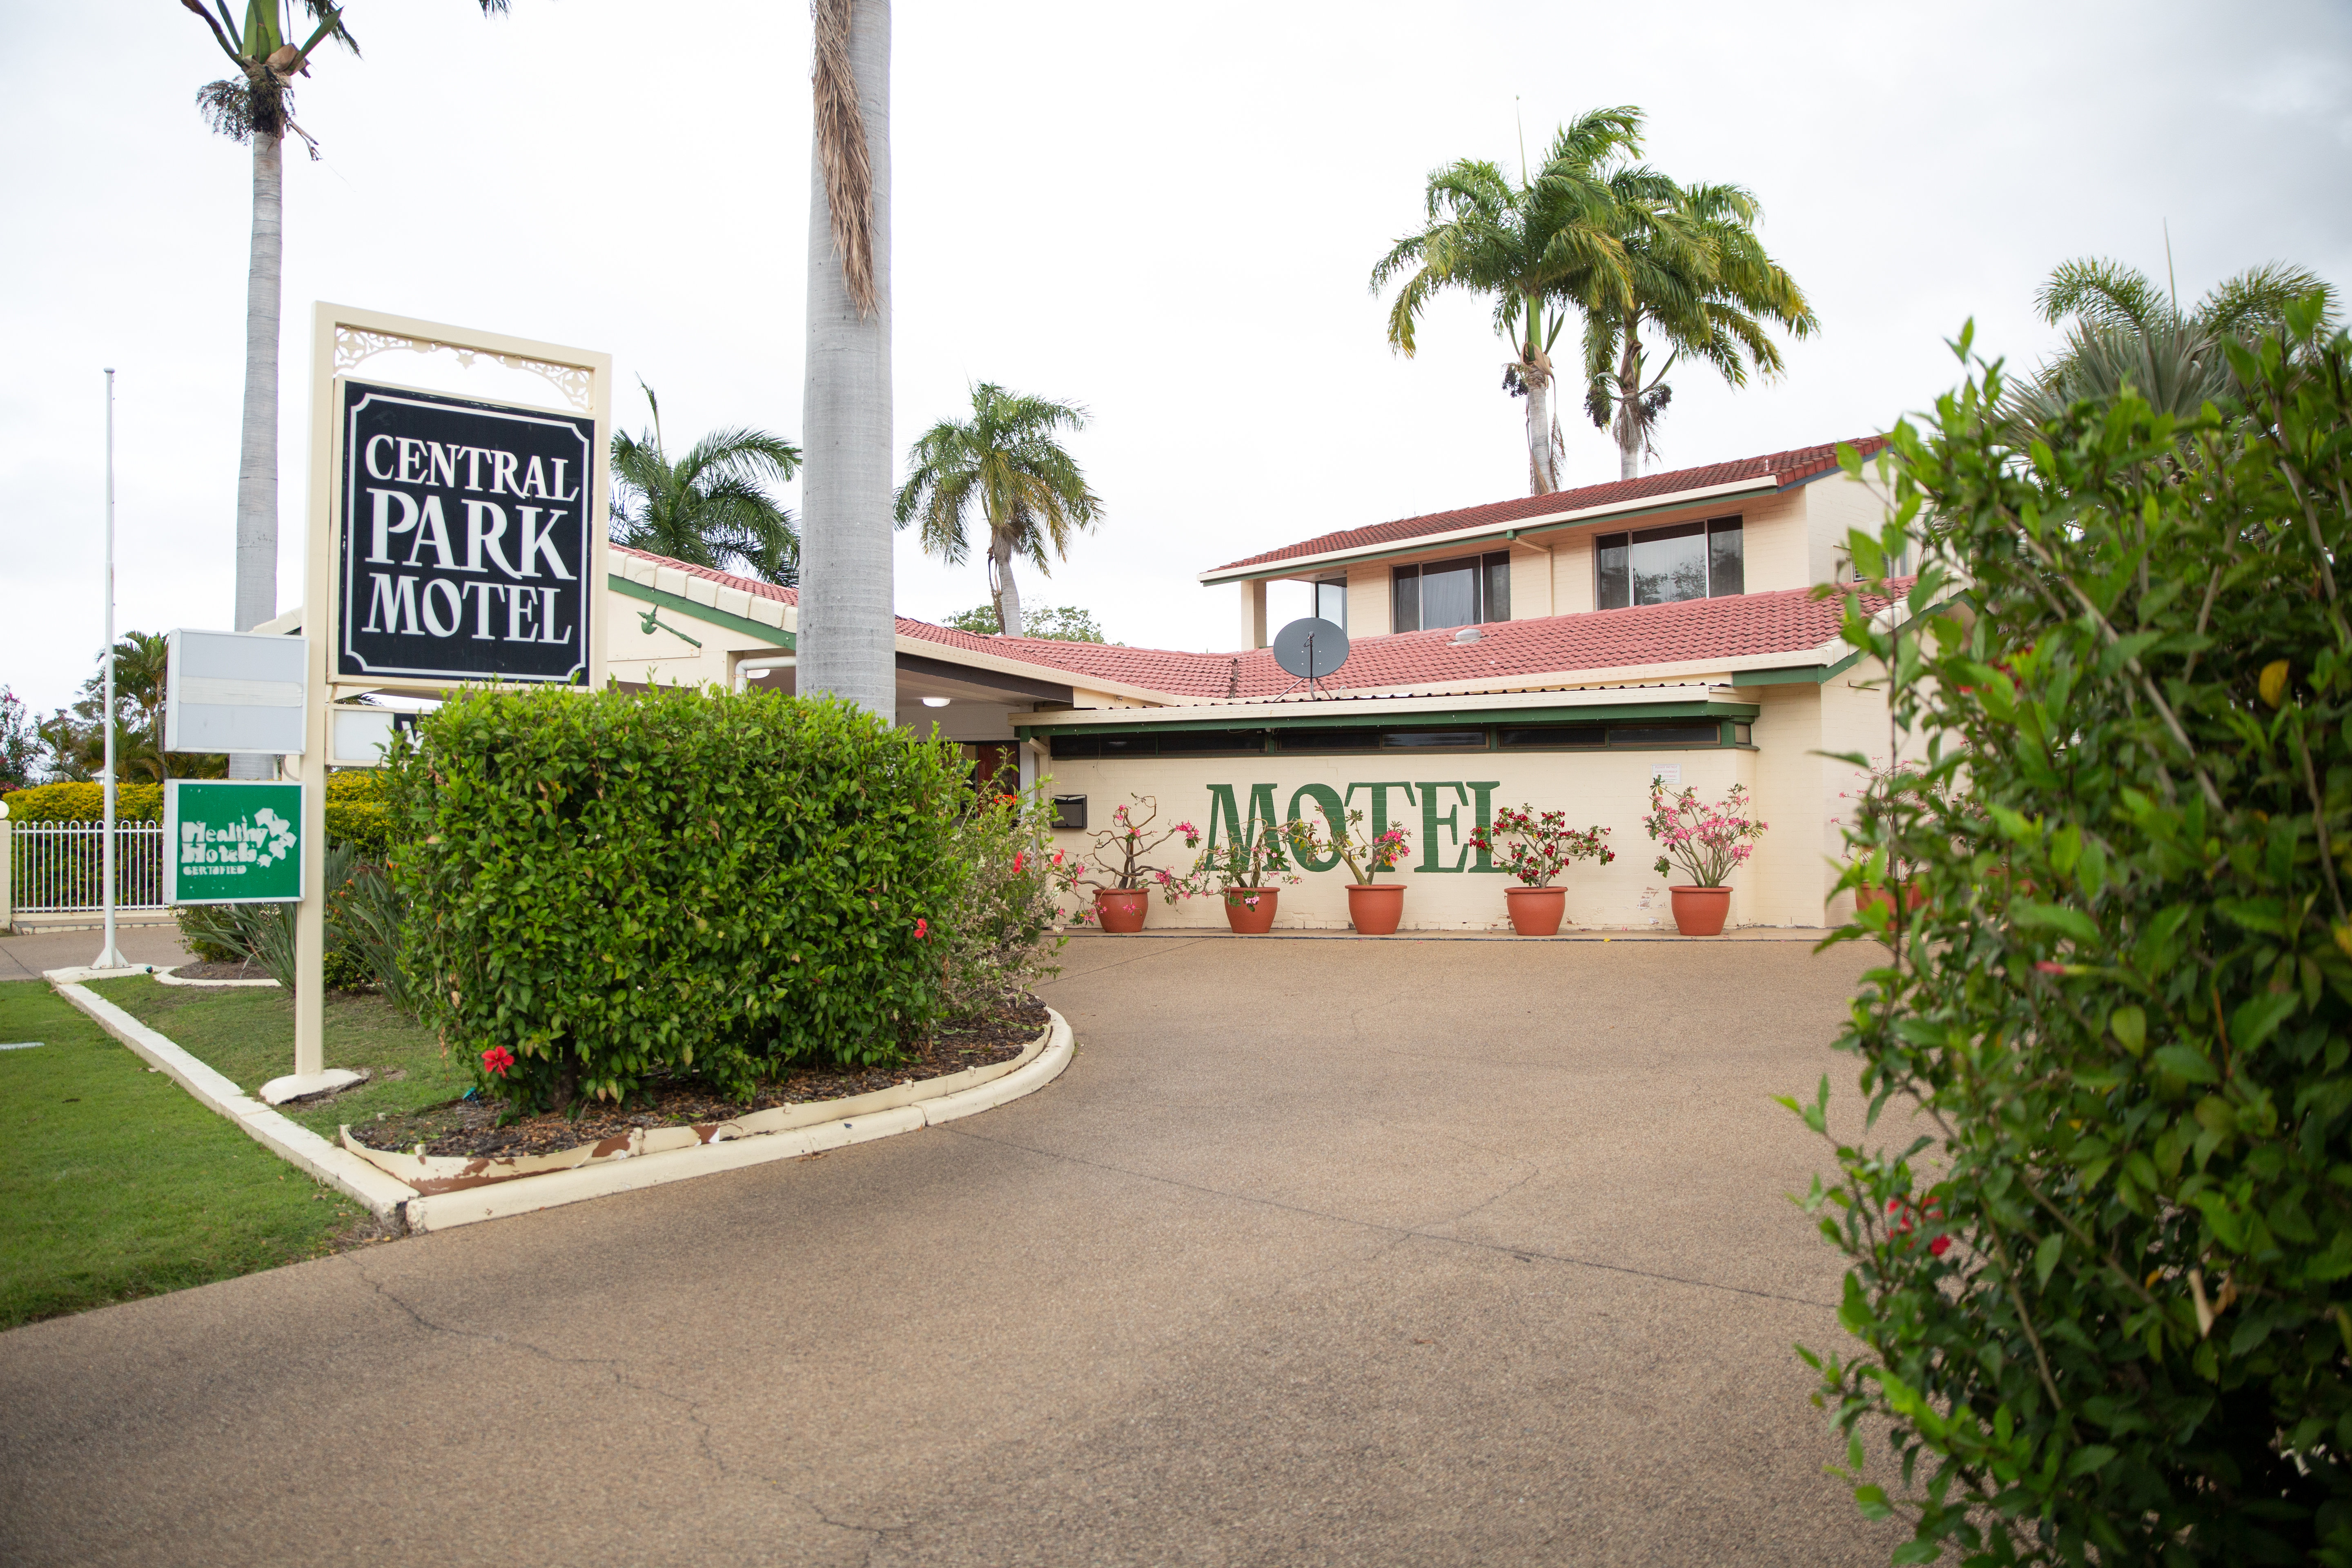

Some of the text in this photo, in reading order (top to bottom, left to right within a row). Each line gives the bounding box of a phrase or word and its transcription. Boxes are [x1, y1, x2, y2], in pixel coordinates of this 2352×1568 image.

[365, 434, 579, 501] CENTRAL
[365, 488, 577, 580] PARK
[362, 572, 572, 645] MOTEL
[181, 821, 269, 848] Healthy
[181, 842, 257, 863] Hotels
[1201, 781, 1527, 873] MOTEL
[183, 865, 247, 875] CERTIFIED
